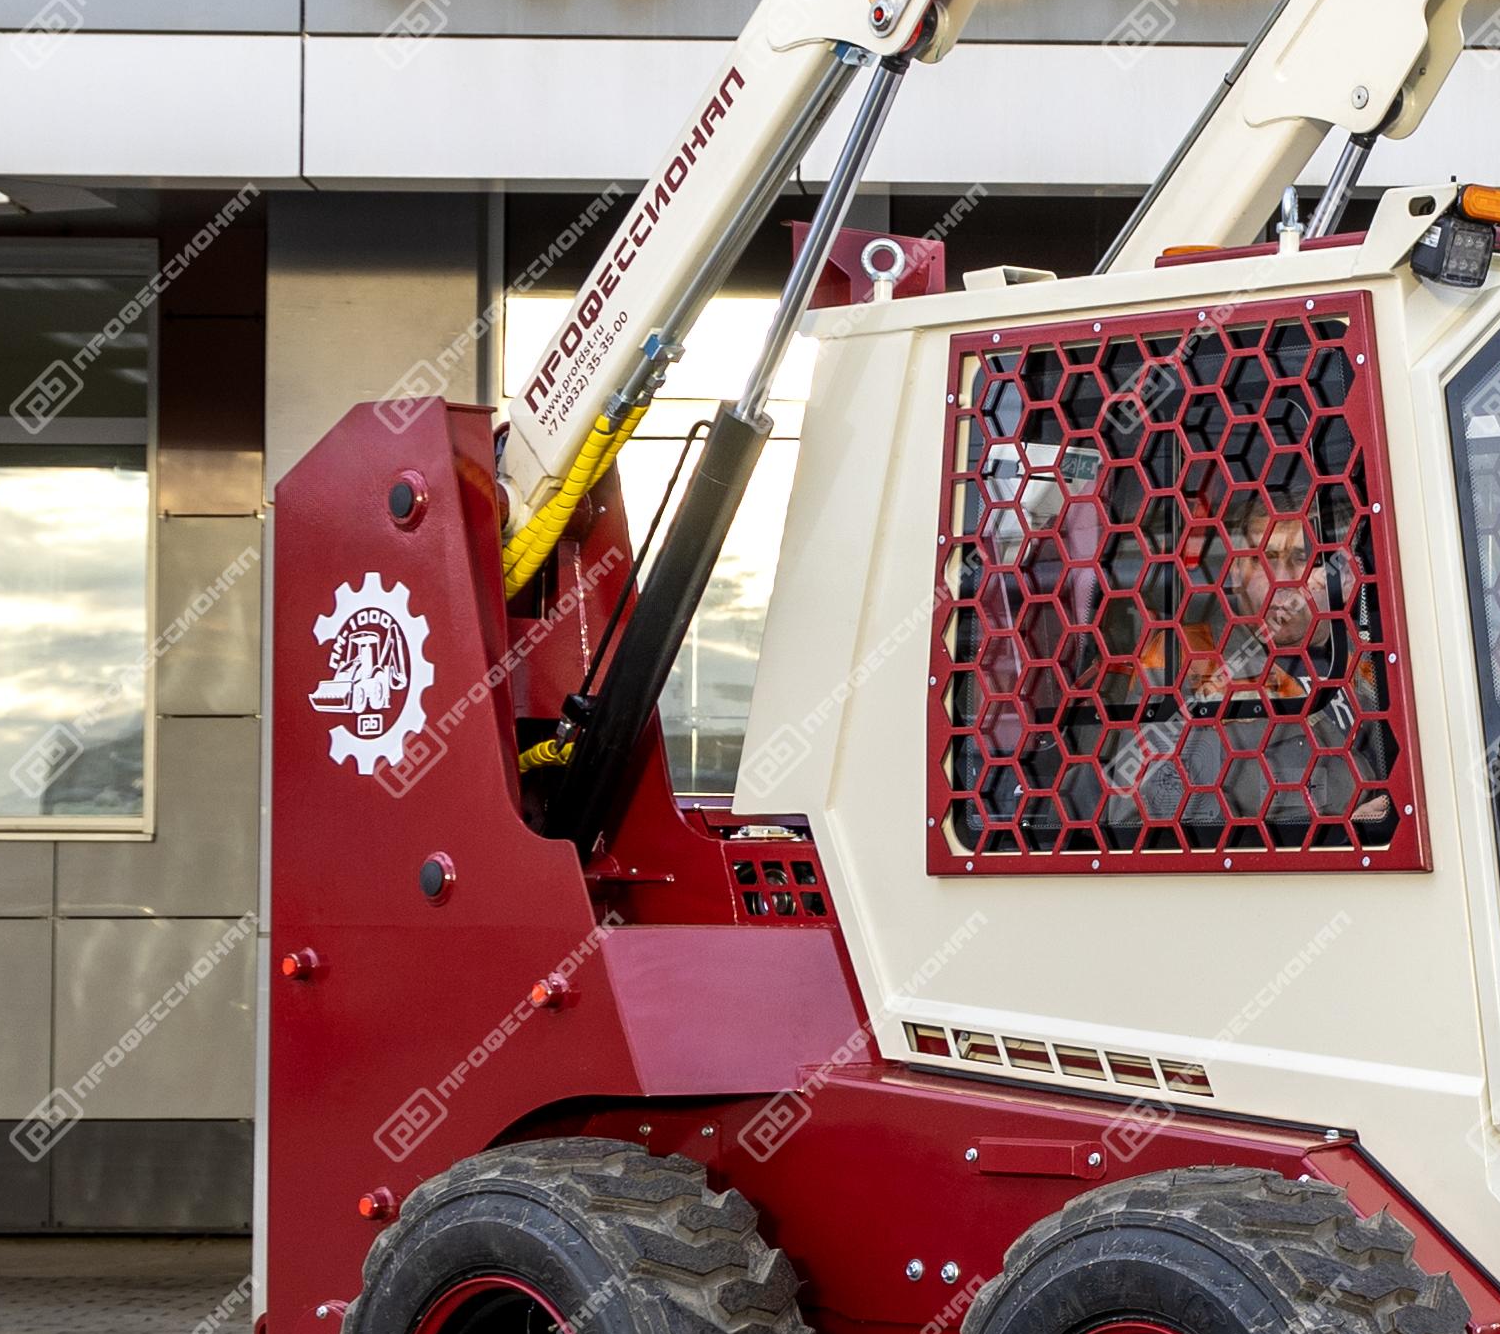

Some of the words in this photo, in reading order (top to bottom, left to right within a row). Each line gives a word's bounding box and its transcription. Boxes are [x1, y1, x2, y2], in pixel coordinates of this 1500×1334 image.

[523, 65, 747, 415] ПРОФЕССИОНАЛ
[538, 324, 605, 427] www.profdst.ru
[547, 418, 560, 437] +7
[557, 374, 590, 423] (4932)
[586, 310, 628, 376] 35-35-00
[328, 609, 392, 671] ПМ-1000
